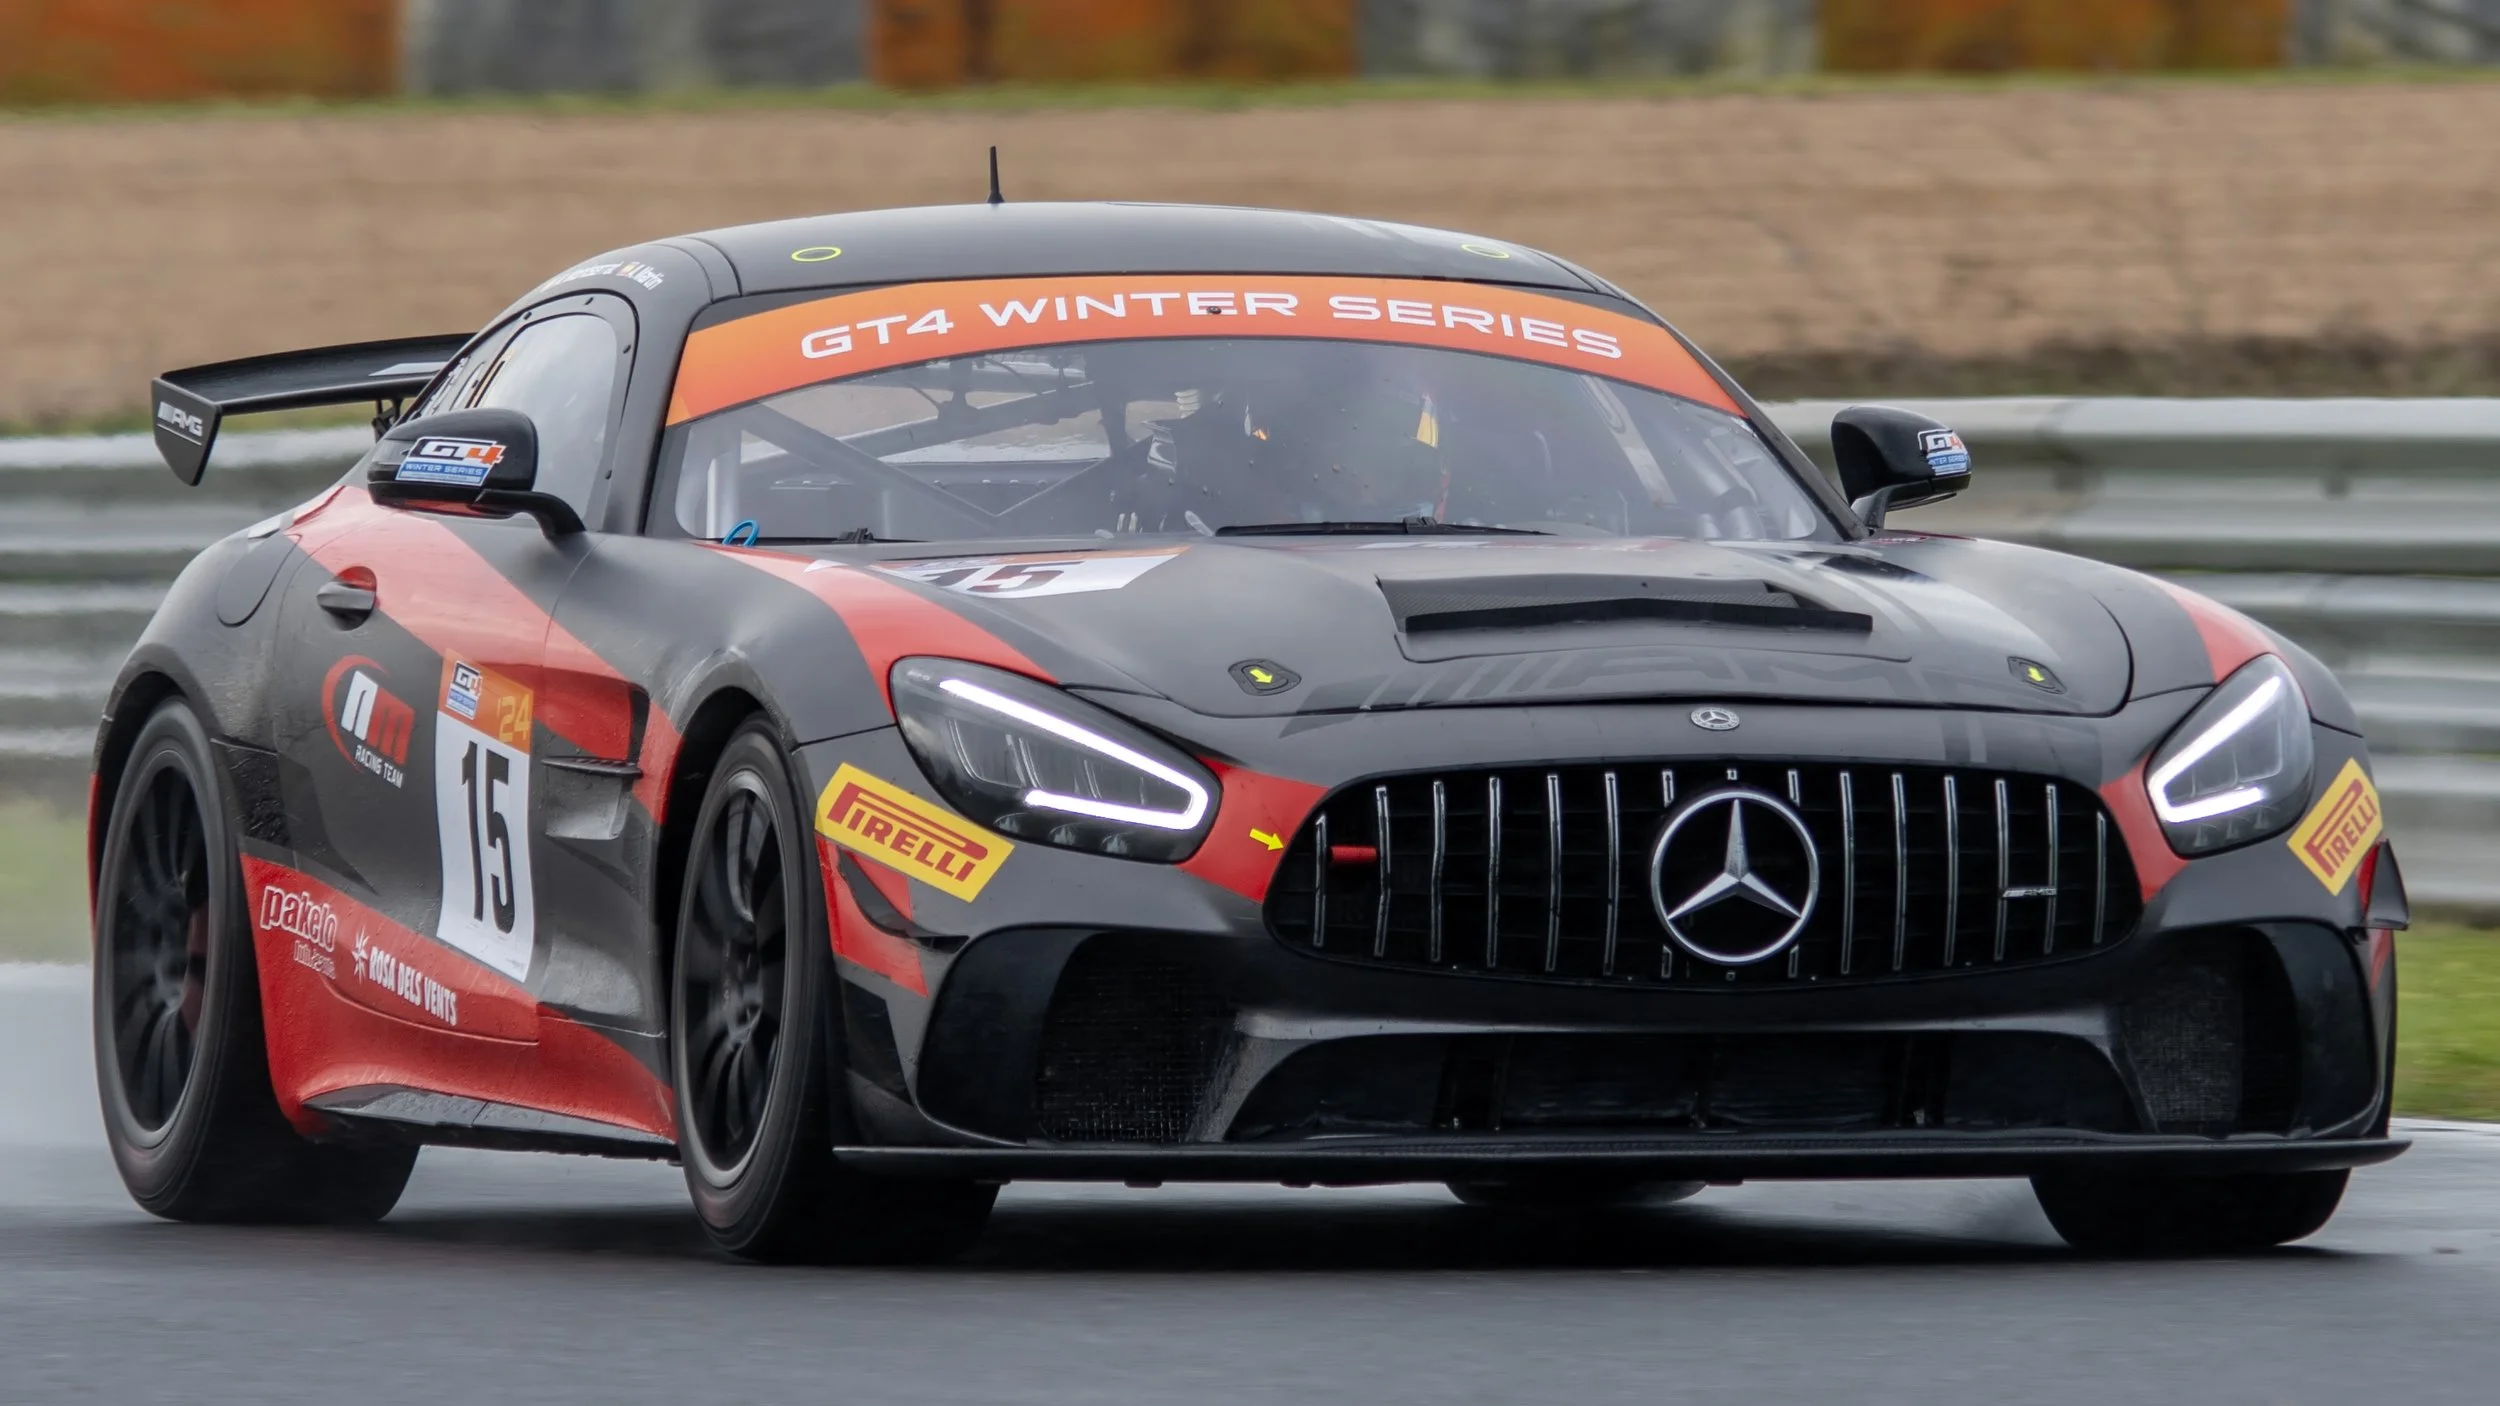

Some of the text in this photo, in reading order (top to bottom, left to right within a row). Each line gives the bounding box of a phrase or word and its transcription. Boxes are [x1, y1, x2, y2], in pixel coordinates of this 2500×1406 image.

[801, 291, 1622, 359] GT4 WINTER SERIES
[405, 463, 484, 476] WINTER SERIES
[420, 440, 504, 465] GT4
[355, 744, 404, 789] RACING TEAM
[462, 740, 516, 934] 15
[827, 781, 989, 883] PIRELLI
[2302, 778, 2378, 879] PIRELLI
[260, 885, 338, 952] pakelo
[368, 946, 396, 992] ROSA
[397, 961, 423, 1006] DELS
[424, 976, 457, 1026] VENTS
